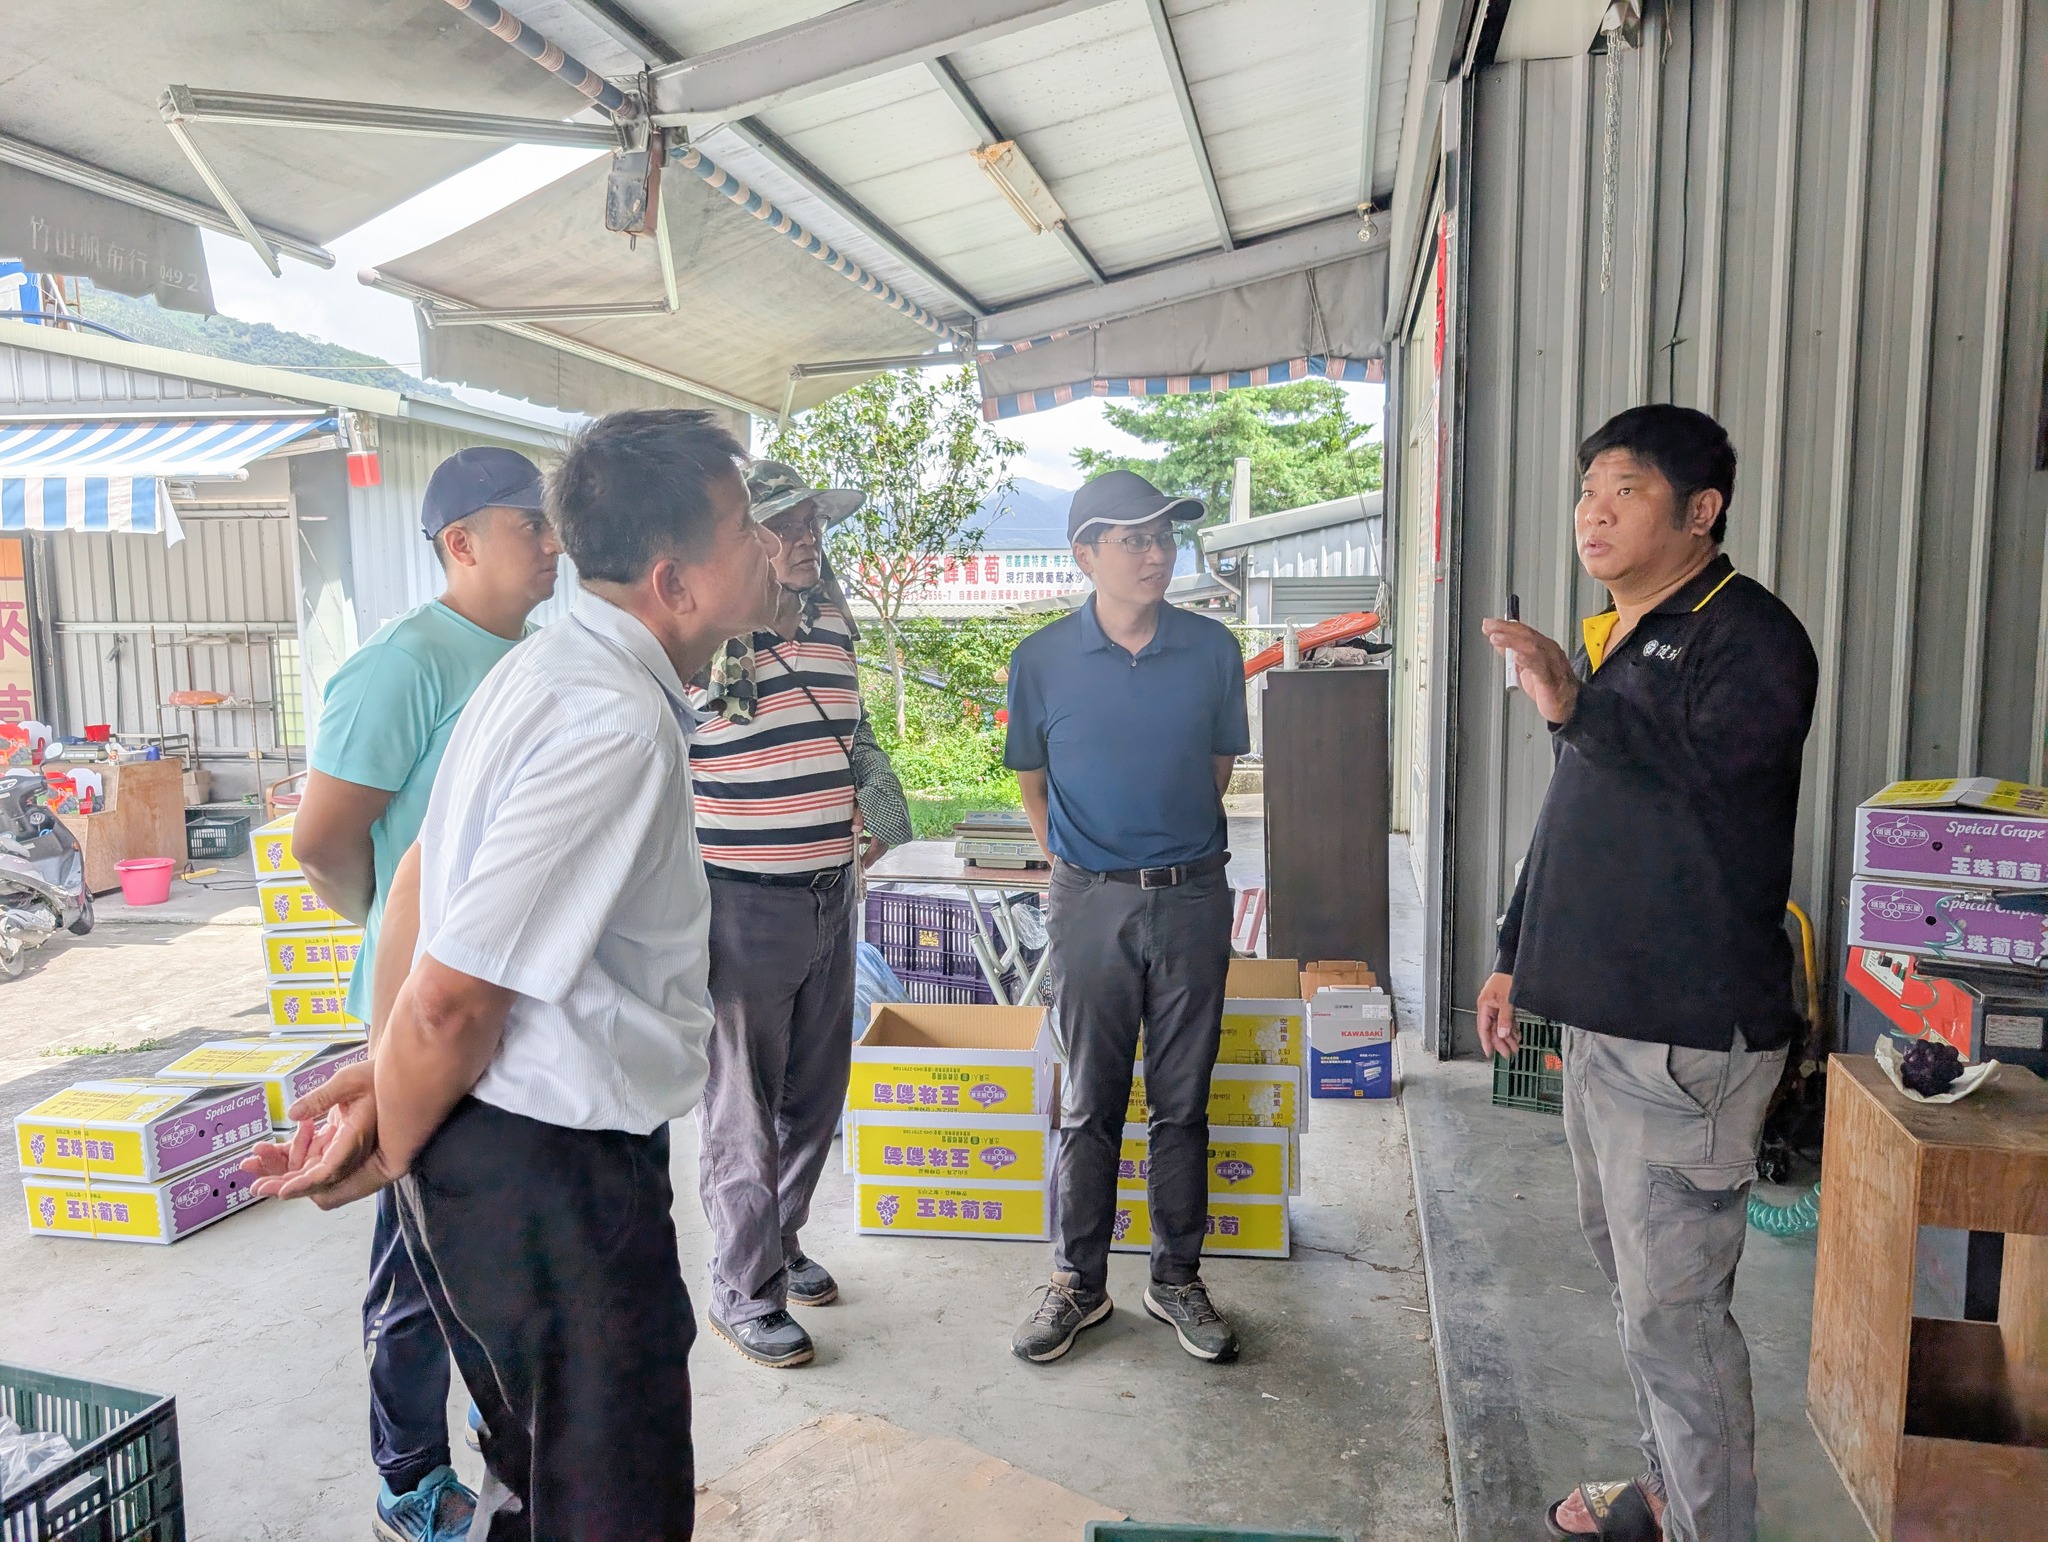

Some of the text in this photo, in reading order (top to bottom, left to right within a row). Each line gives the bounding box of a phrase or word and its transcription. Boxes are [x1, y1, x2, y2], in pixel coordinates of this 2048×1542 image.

[159, 264, 183, 283] 049
[1946, 821, 2046, 842] Speical Grape
[1950, 857, 2042, 881] 玉珠葡萄
[1944, 932, 2036, 958] 玉珠葡萄
[874, 1083, 960, 1106] 玉珠葡萄
[205, 1093, 261, 1121] Speical Grape
[212, 1119, 263, 1151] 玉珠葡萄
[57, 1138, 115, 1161] 玉珠葡萄
[884, 1146, 970, 1168] 玉珠葡萄
[67, 1200, 129, 1223] 玉珠葡萄
[916, 1198, 1003, 1221] 玉珠葡萄
